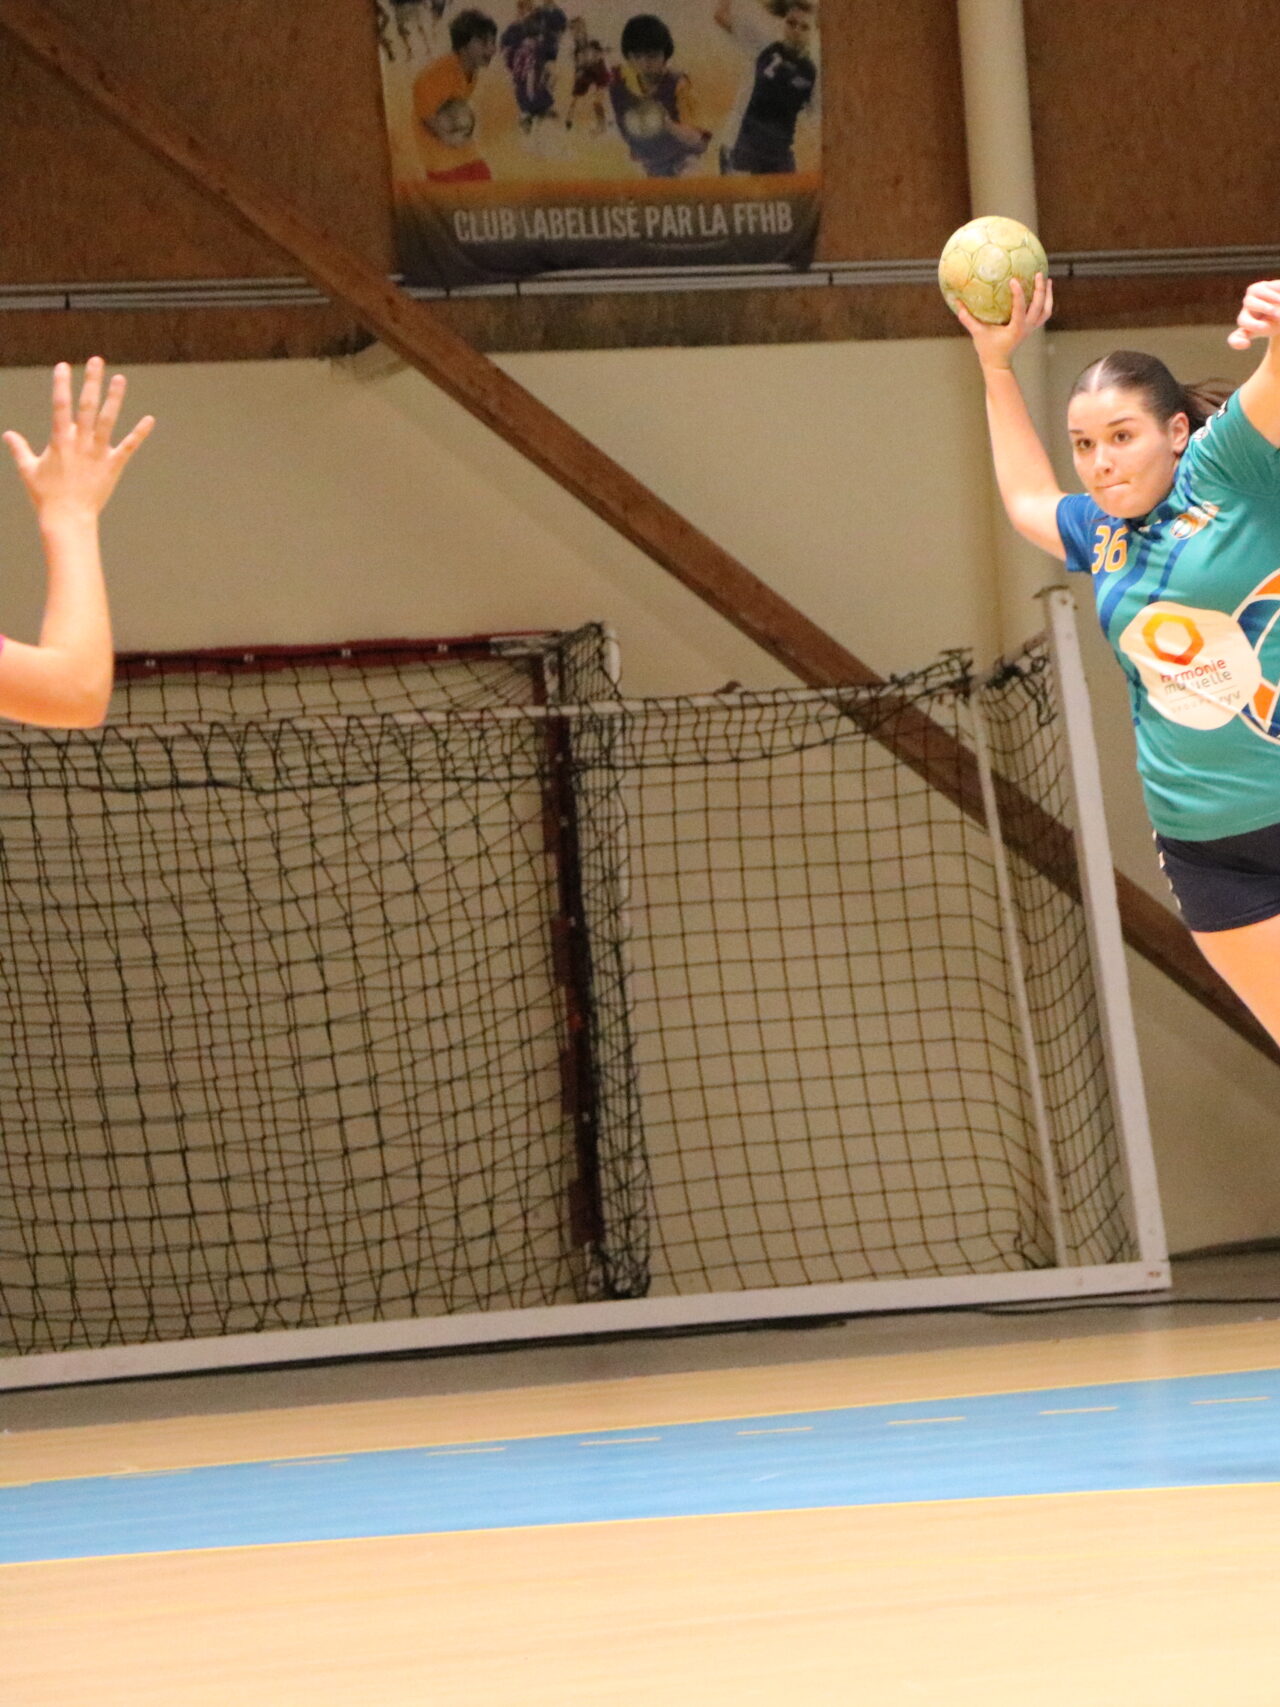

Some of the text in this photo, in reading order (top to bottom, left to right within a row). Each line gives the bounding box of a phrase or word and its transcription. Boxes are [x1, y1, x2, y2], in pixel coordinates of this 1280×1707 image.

[453, 201, 794, 243] CLUB LABELLISÉ PAR LA FFHB
[1091, 525, 1129, 574] 36
[1160, 659, 1227, 683] hrmonie
